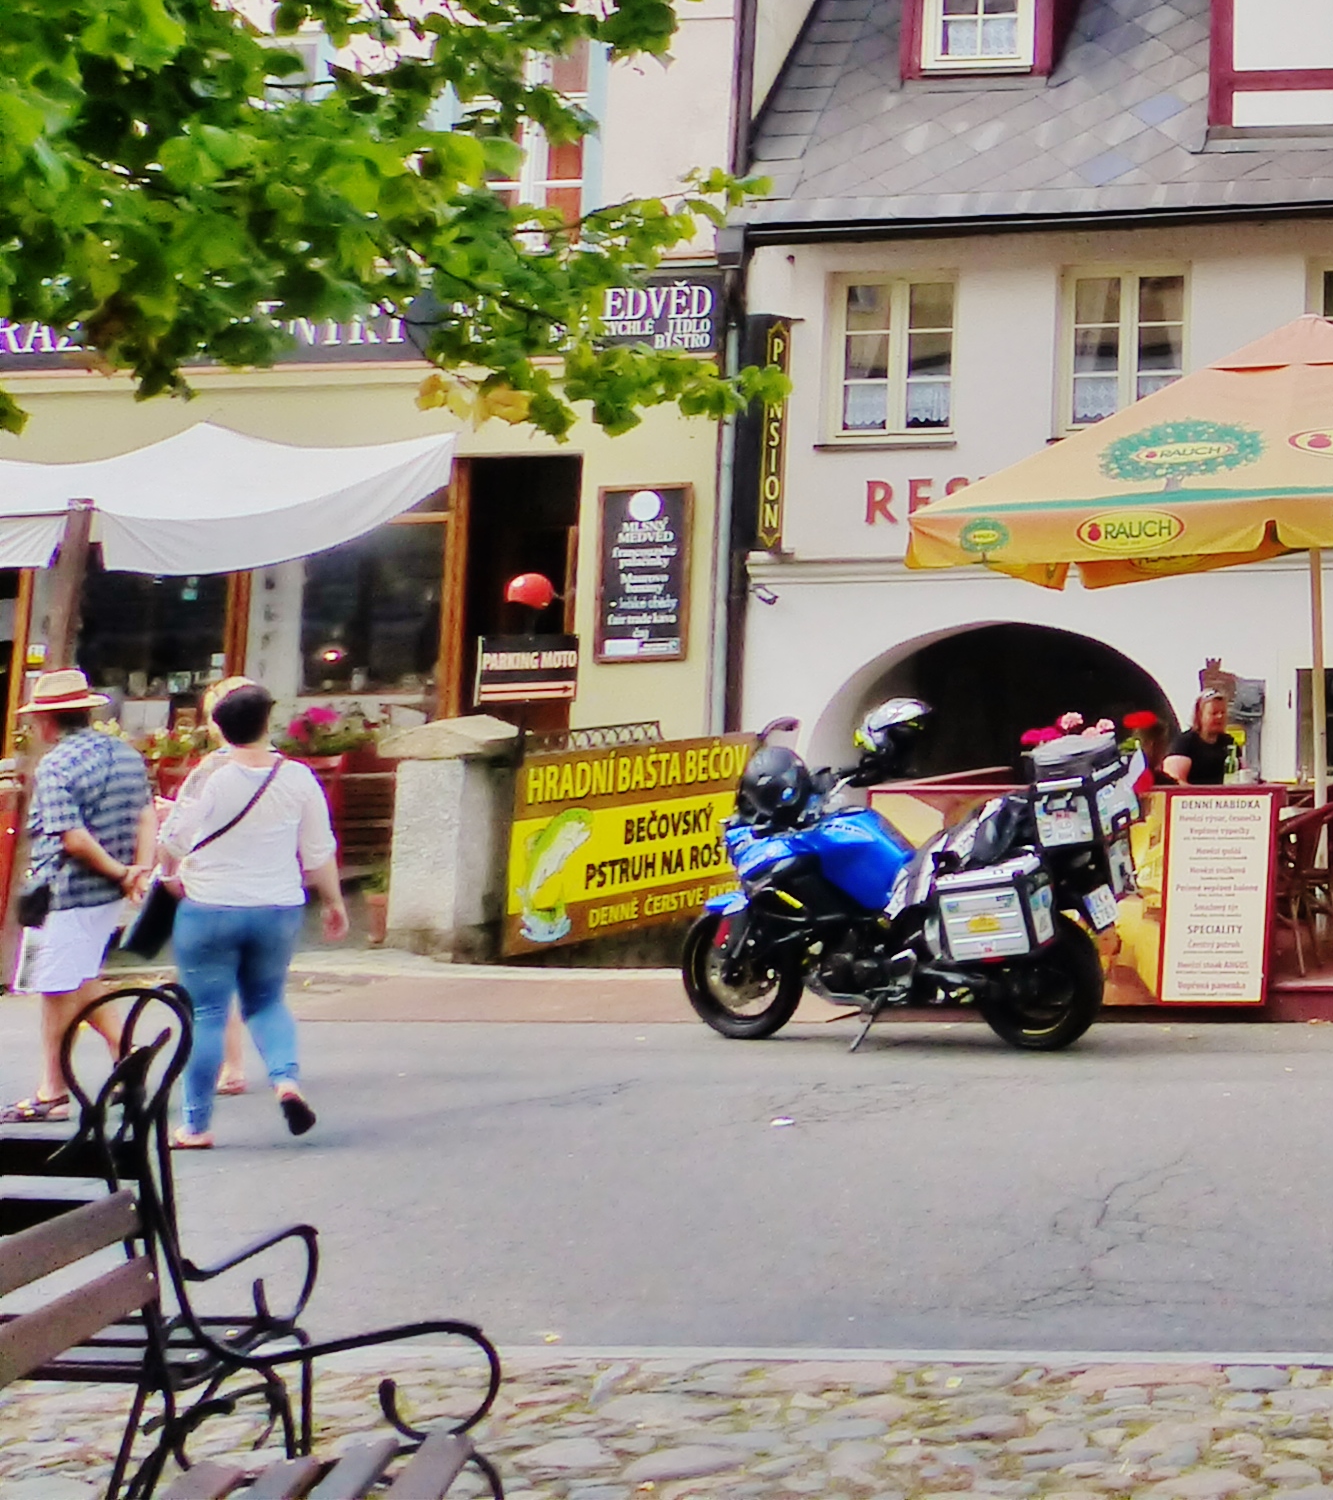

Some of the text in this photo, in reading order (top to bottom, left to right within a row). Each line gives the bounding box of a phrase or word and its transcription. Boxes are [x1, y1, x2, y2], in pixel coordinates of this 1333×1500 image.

[598, 280, 713, 320] EDVĚD
[654, 332, 712, 350] BISTRO
[763, 337, 785, 529] PNSION
[1158, 445, 1222, 460] RAUCH
[1103, 519, 1172, 540] RAUCH
[482, 650, 578, 671] PARKING MOTO
[526, 739, 749, 805] HRADNÍ BAŠTA BEČOV
[1181, 798, 1261, 809] DENNÍ NABÍDKA
[623, 802, 714, 845] BEČOVSKÝ
[584, 836, 730, 891] PSTRUH NA ROŠT
[588, 897, 639, 929] DENNĚ
[1187, 925, 1243, 935] SPECIALITY
